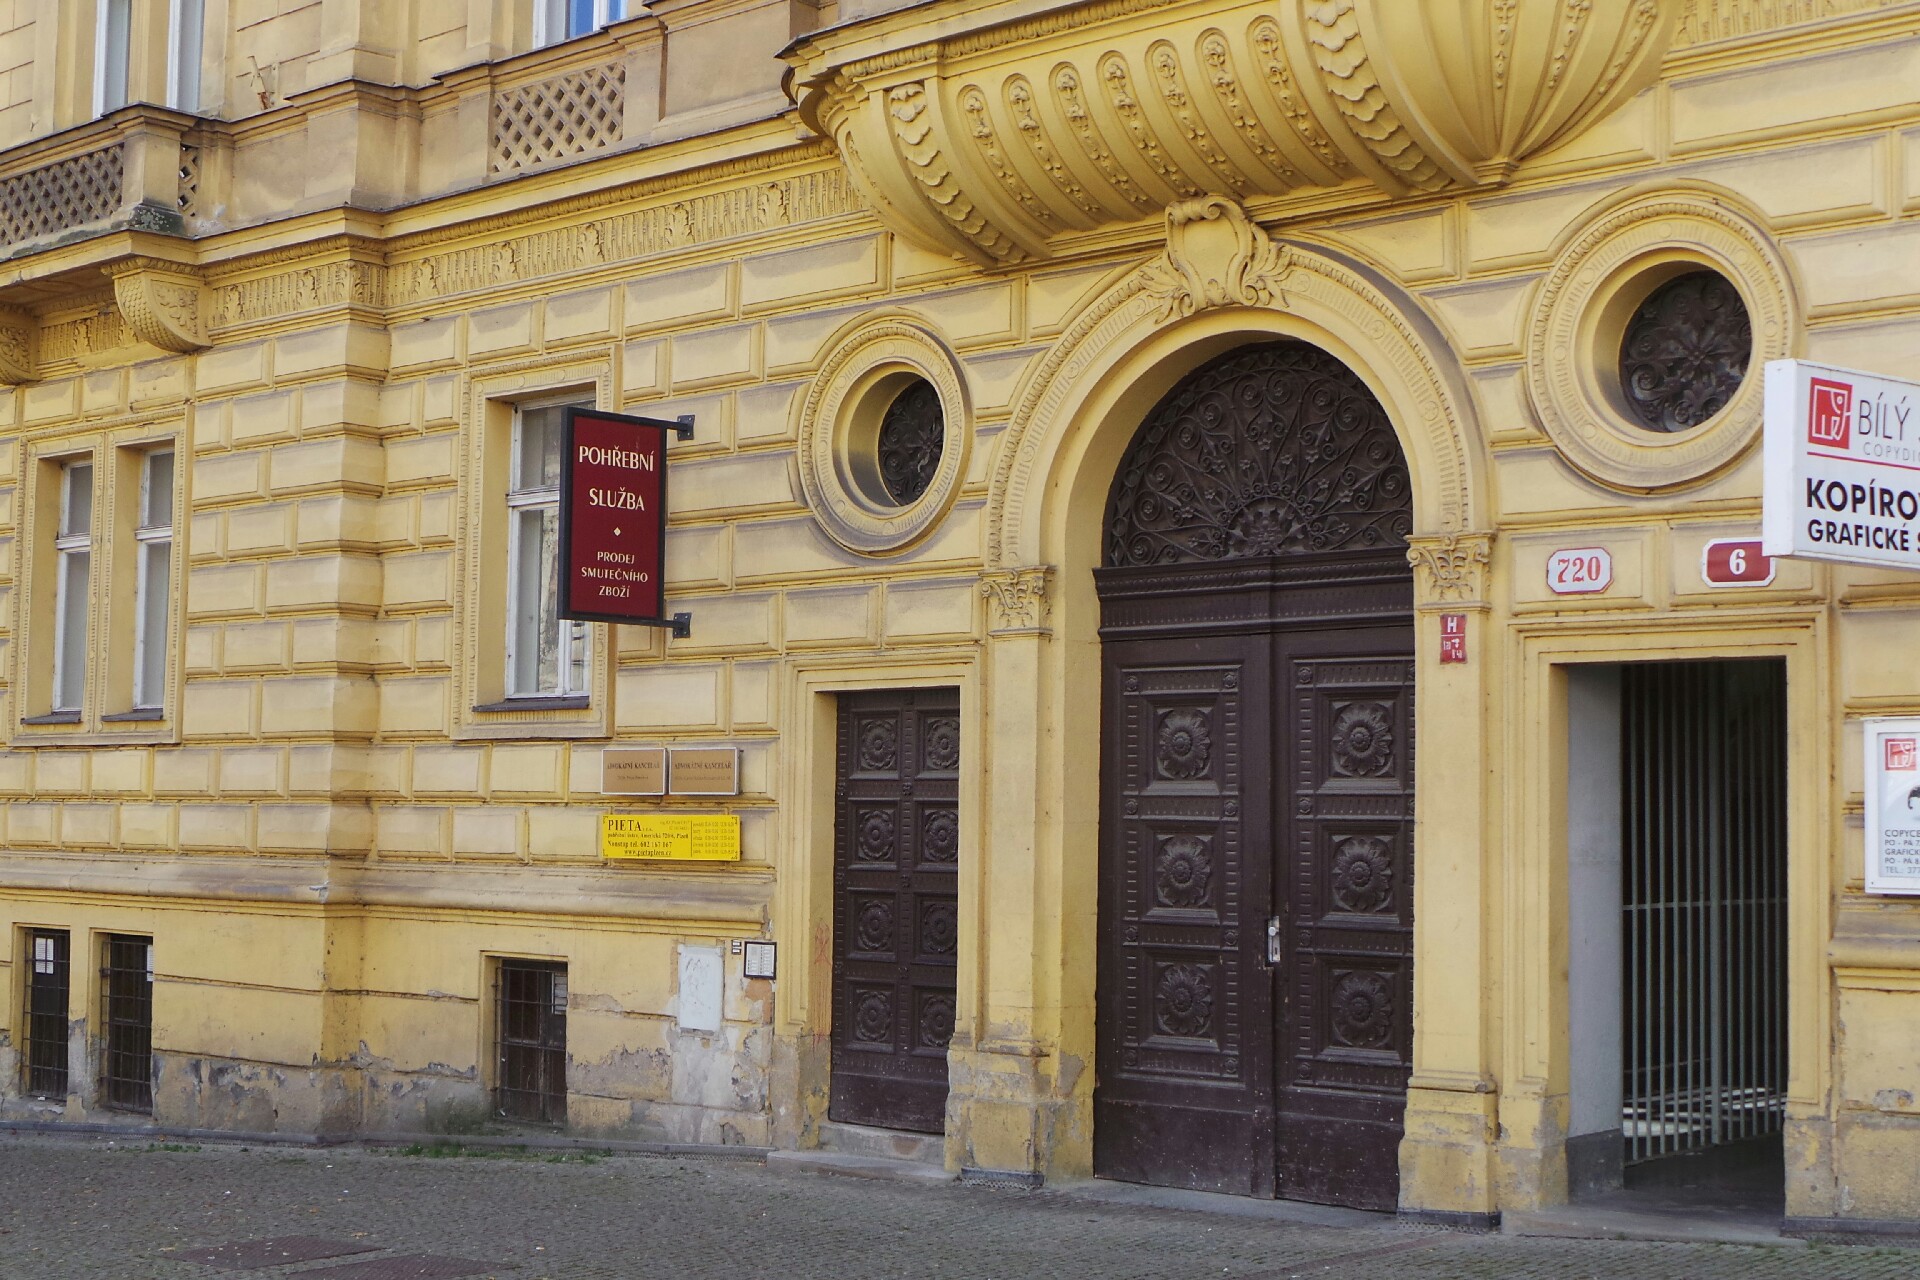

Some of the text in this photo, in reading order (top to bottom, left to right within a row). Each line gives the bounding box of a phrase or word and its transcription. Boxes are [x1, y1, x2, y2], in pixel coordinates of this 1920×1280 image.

[1858, 391, 1911, 441] BÍLÝ
[578, 444, 655, 472] POHŘEBNÍ
[589, 487, 645, 511] SLUŽBA
[1806, 477, 1920, 520] KOPÍRO
[1807, 519, 1910, 551] GRAFICKÉ
[597, 551, 635, 564] PRODEJ
[1729, 549, 1747, 576] 6
[581, 566, 649, 583] SMUTEČNÍHO
[1556, 556, 1602, 584] 720
[598, 585, 631, 598] ZBOŽÍ
[1447, 616, 1457, 633] H
[608, 819, 642, 832] PIETA
[1884, 848, 1920, 856] GRAFICK
